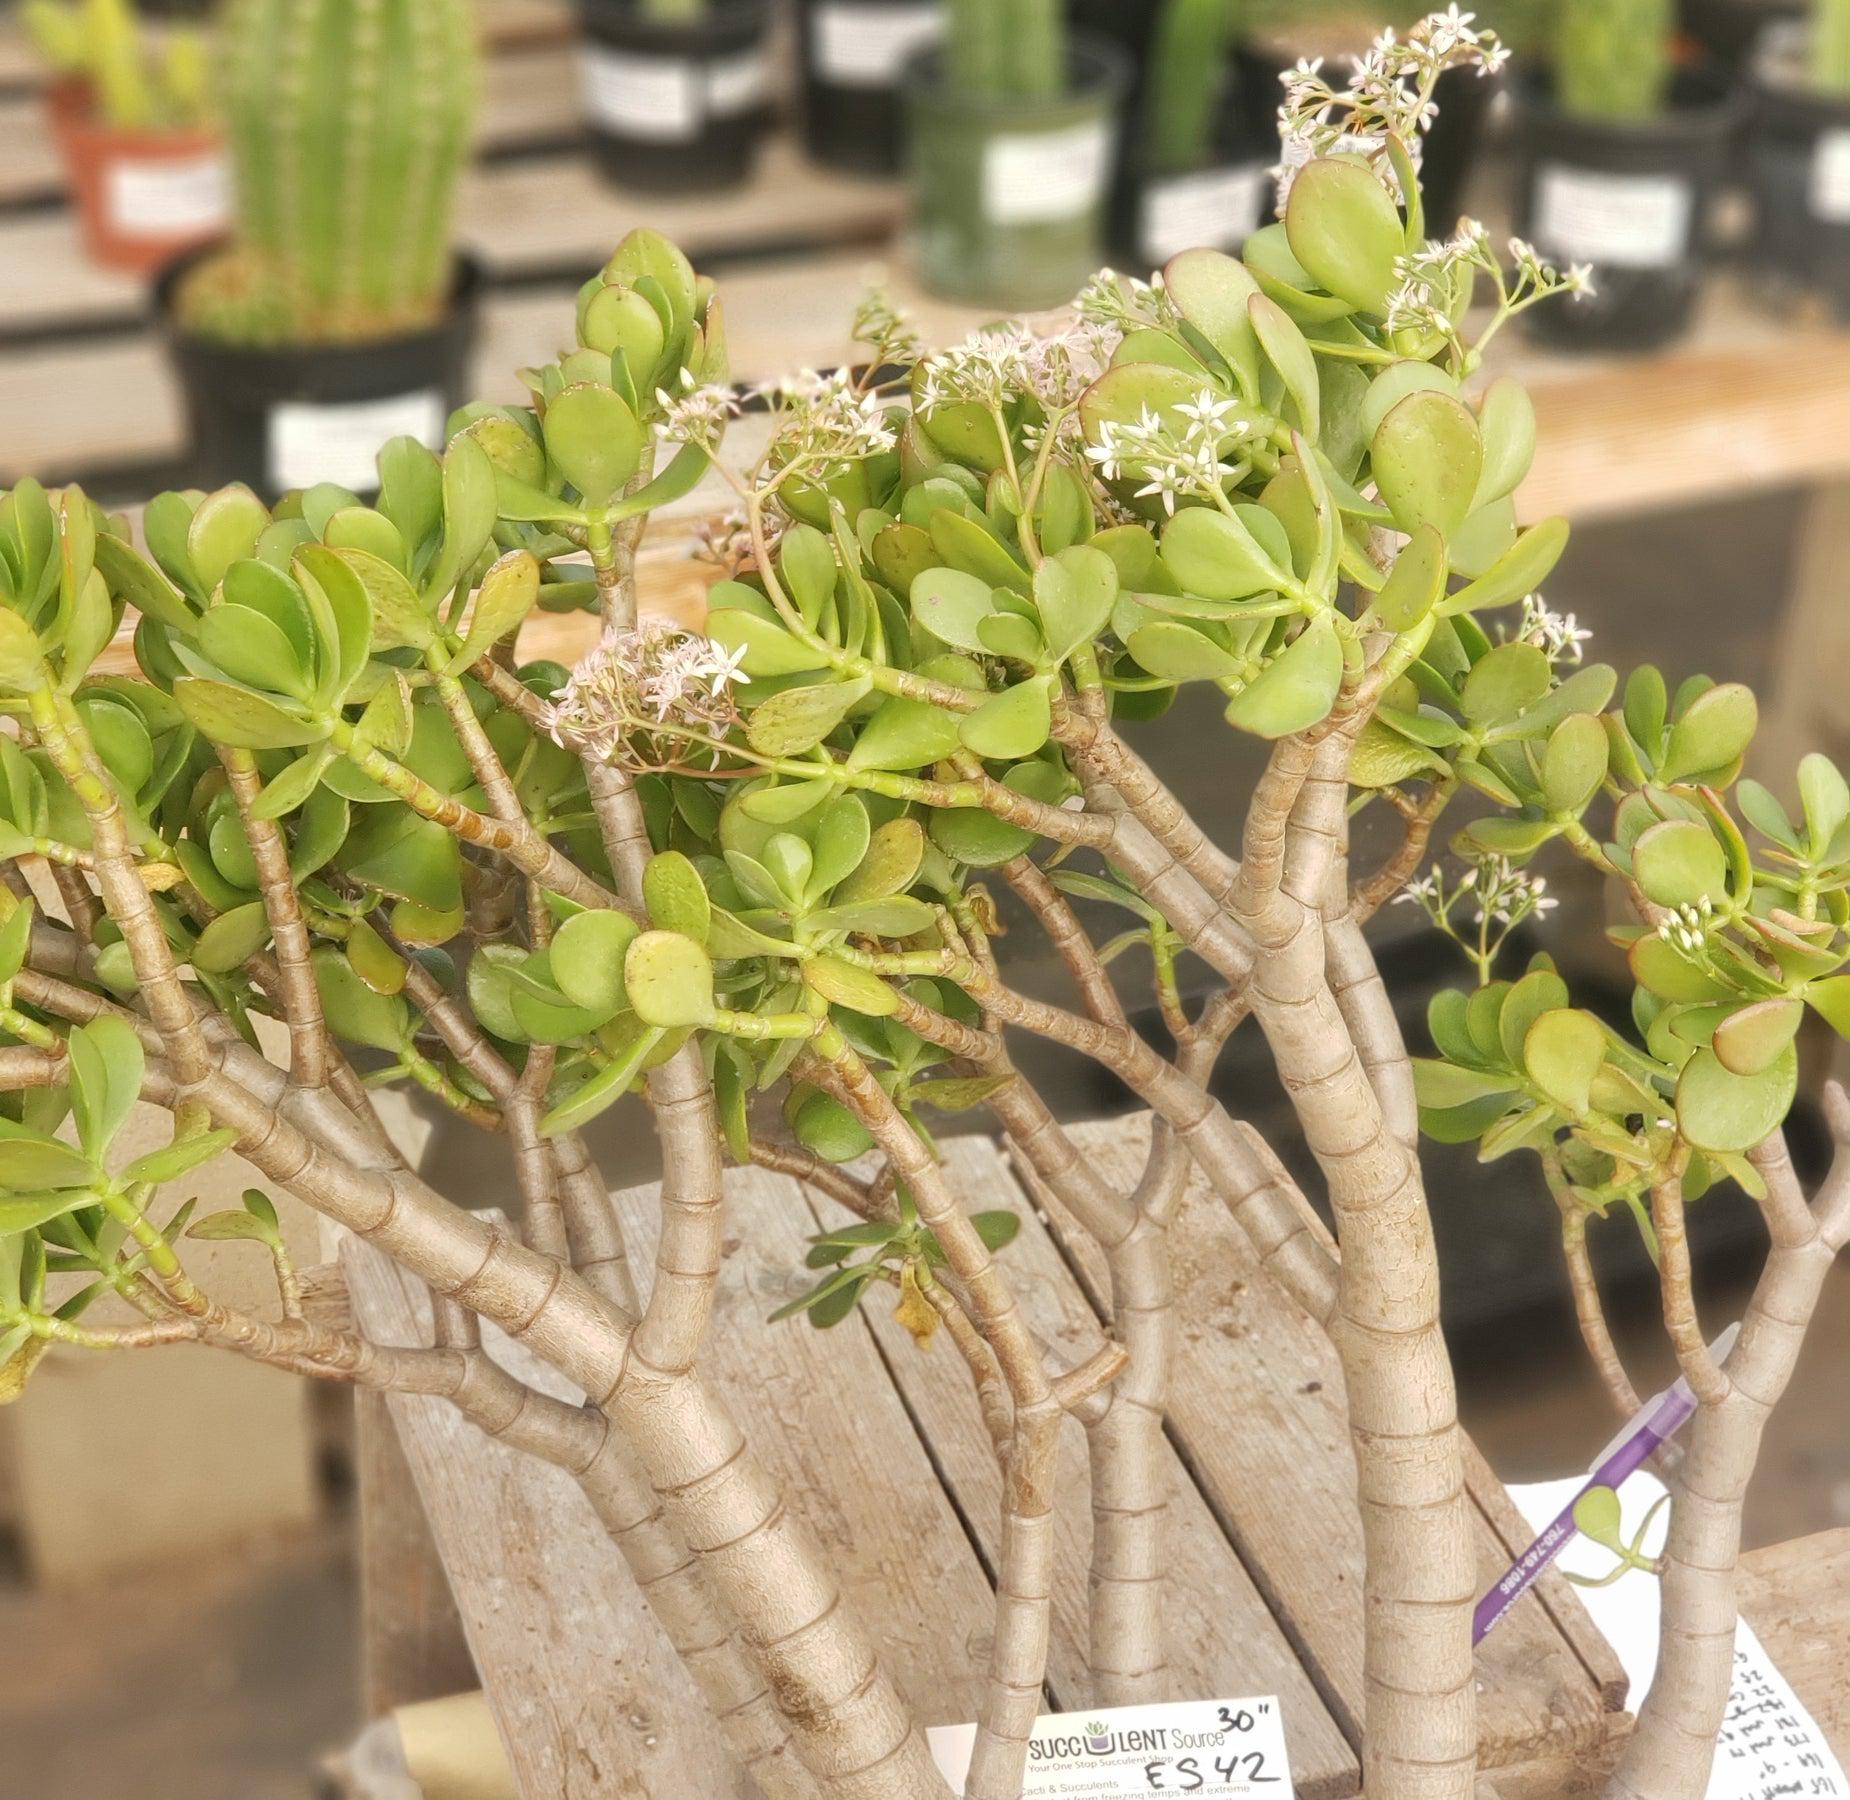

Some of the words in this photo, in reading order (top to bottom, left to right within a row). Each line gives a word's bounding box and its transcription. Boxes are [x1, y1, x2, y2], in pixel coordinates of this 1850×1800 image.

[1217, 1703, 1269, 1732] 30"
[1172, 1728, 1225, 1749] Source
[1028, 1764, 1050, 1774] Your
[1052, 1762, 1073, 1771] One
[1075, 1759, 1098, 1769] Stop
[1099, 1755, 1148, 1767] Succulent
[1148, 1754, 1174, 1764] Shop
[1214, 1751, 1282, 1783] 42
[1049, 1784, 1057, 1793] &
[1060, 1780, 1119, 1792] Succulents
[1147, 1789, 1181, 1800] temps
[1206, 1784, 1251, 1795] extreme
